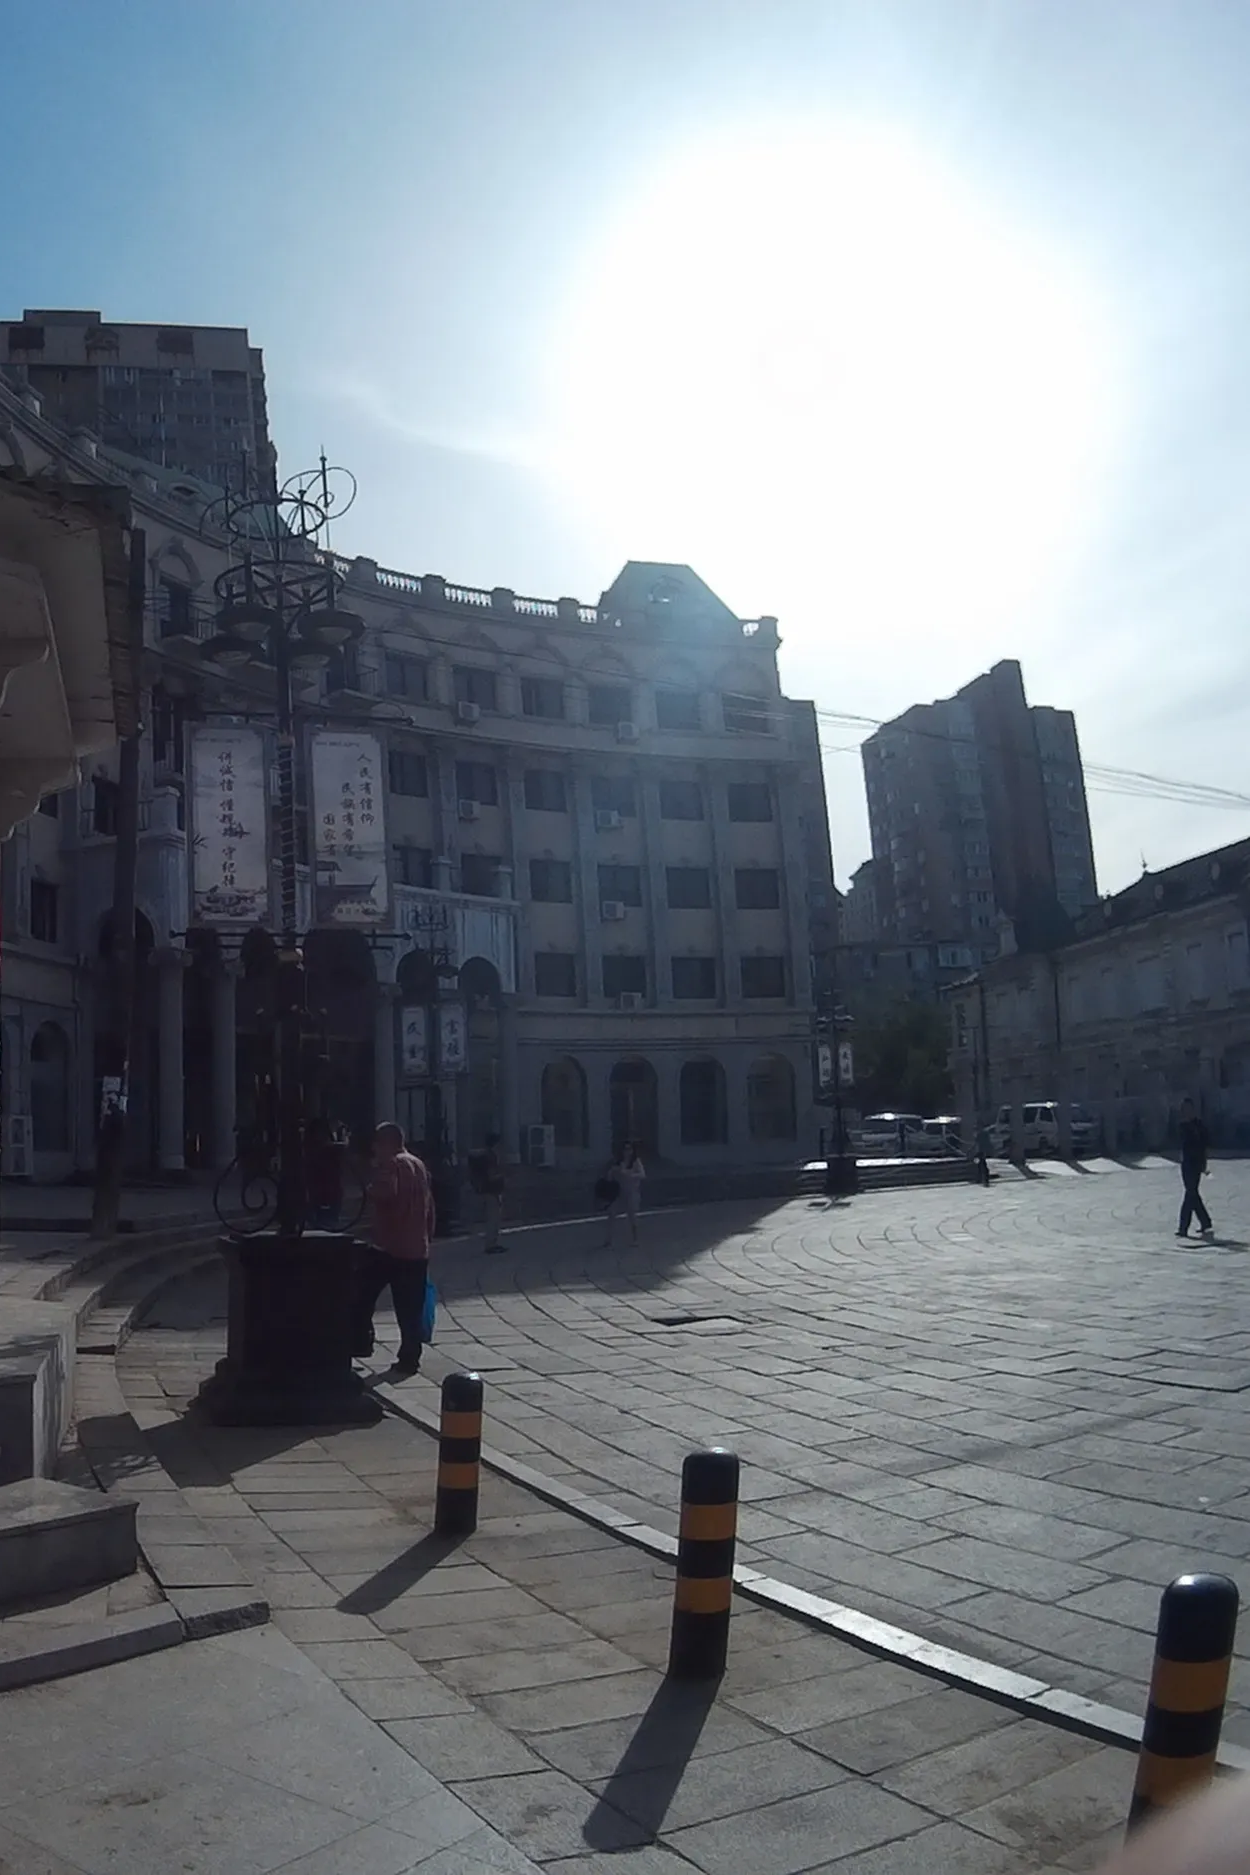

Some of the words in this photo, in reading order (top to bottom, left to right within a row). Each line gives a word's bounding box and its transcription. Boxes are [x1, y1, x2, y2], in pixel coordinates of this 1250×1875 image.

[356, 752, 375, 826] 人民有信仰
